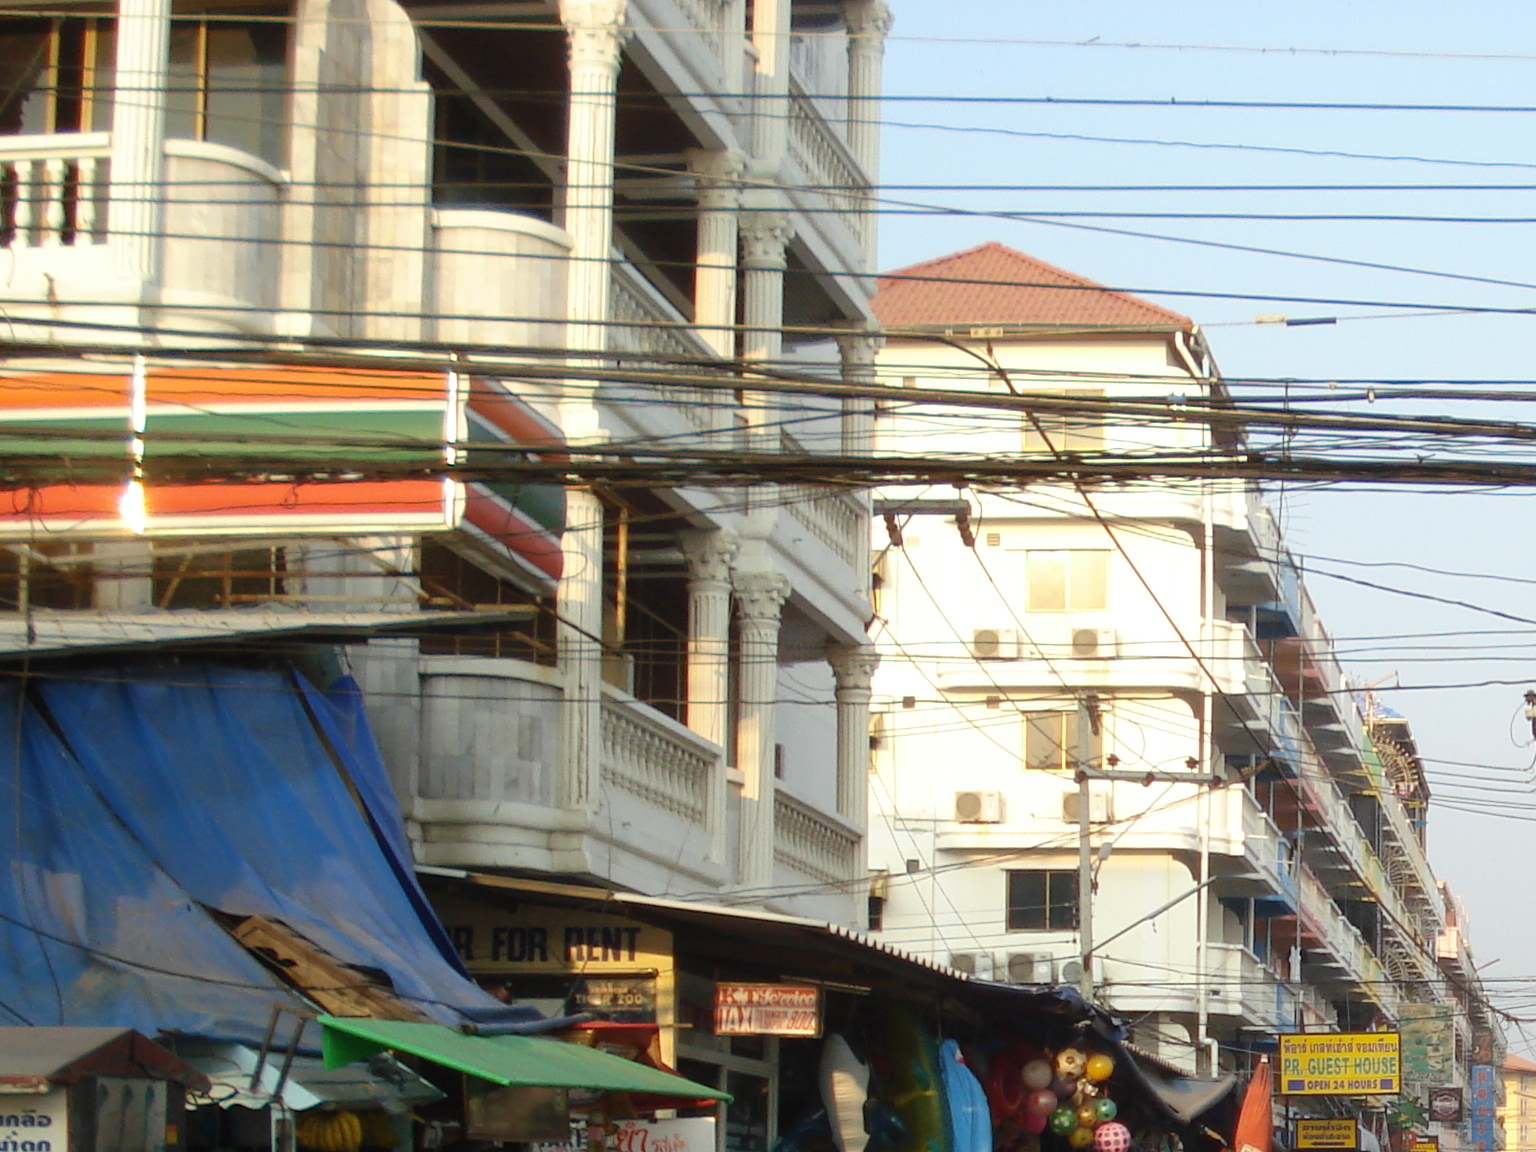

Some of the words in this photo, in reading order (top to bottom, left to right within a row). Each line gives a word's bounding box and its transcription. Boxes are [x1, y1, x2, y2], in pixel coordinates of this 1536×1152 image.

[492, 926, 548, 962] FOR
[563, 926, 641, 962] RENT
[719, 1005, 755, 1033] TAXI
[1307, 1057, 1350, 1075] GUEST
[1354, 1056, 1397, 1075] HOUSE
[1307, 1079, 1331, 1090] OPEN
[1333, 1080, 1345, 1090] 24
[1347, 1078, 1378, 1090] HOURS
